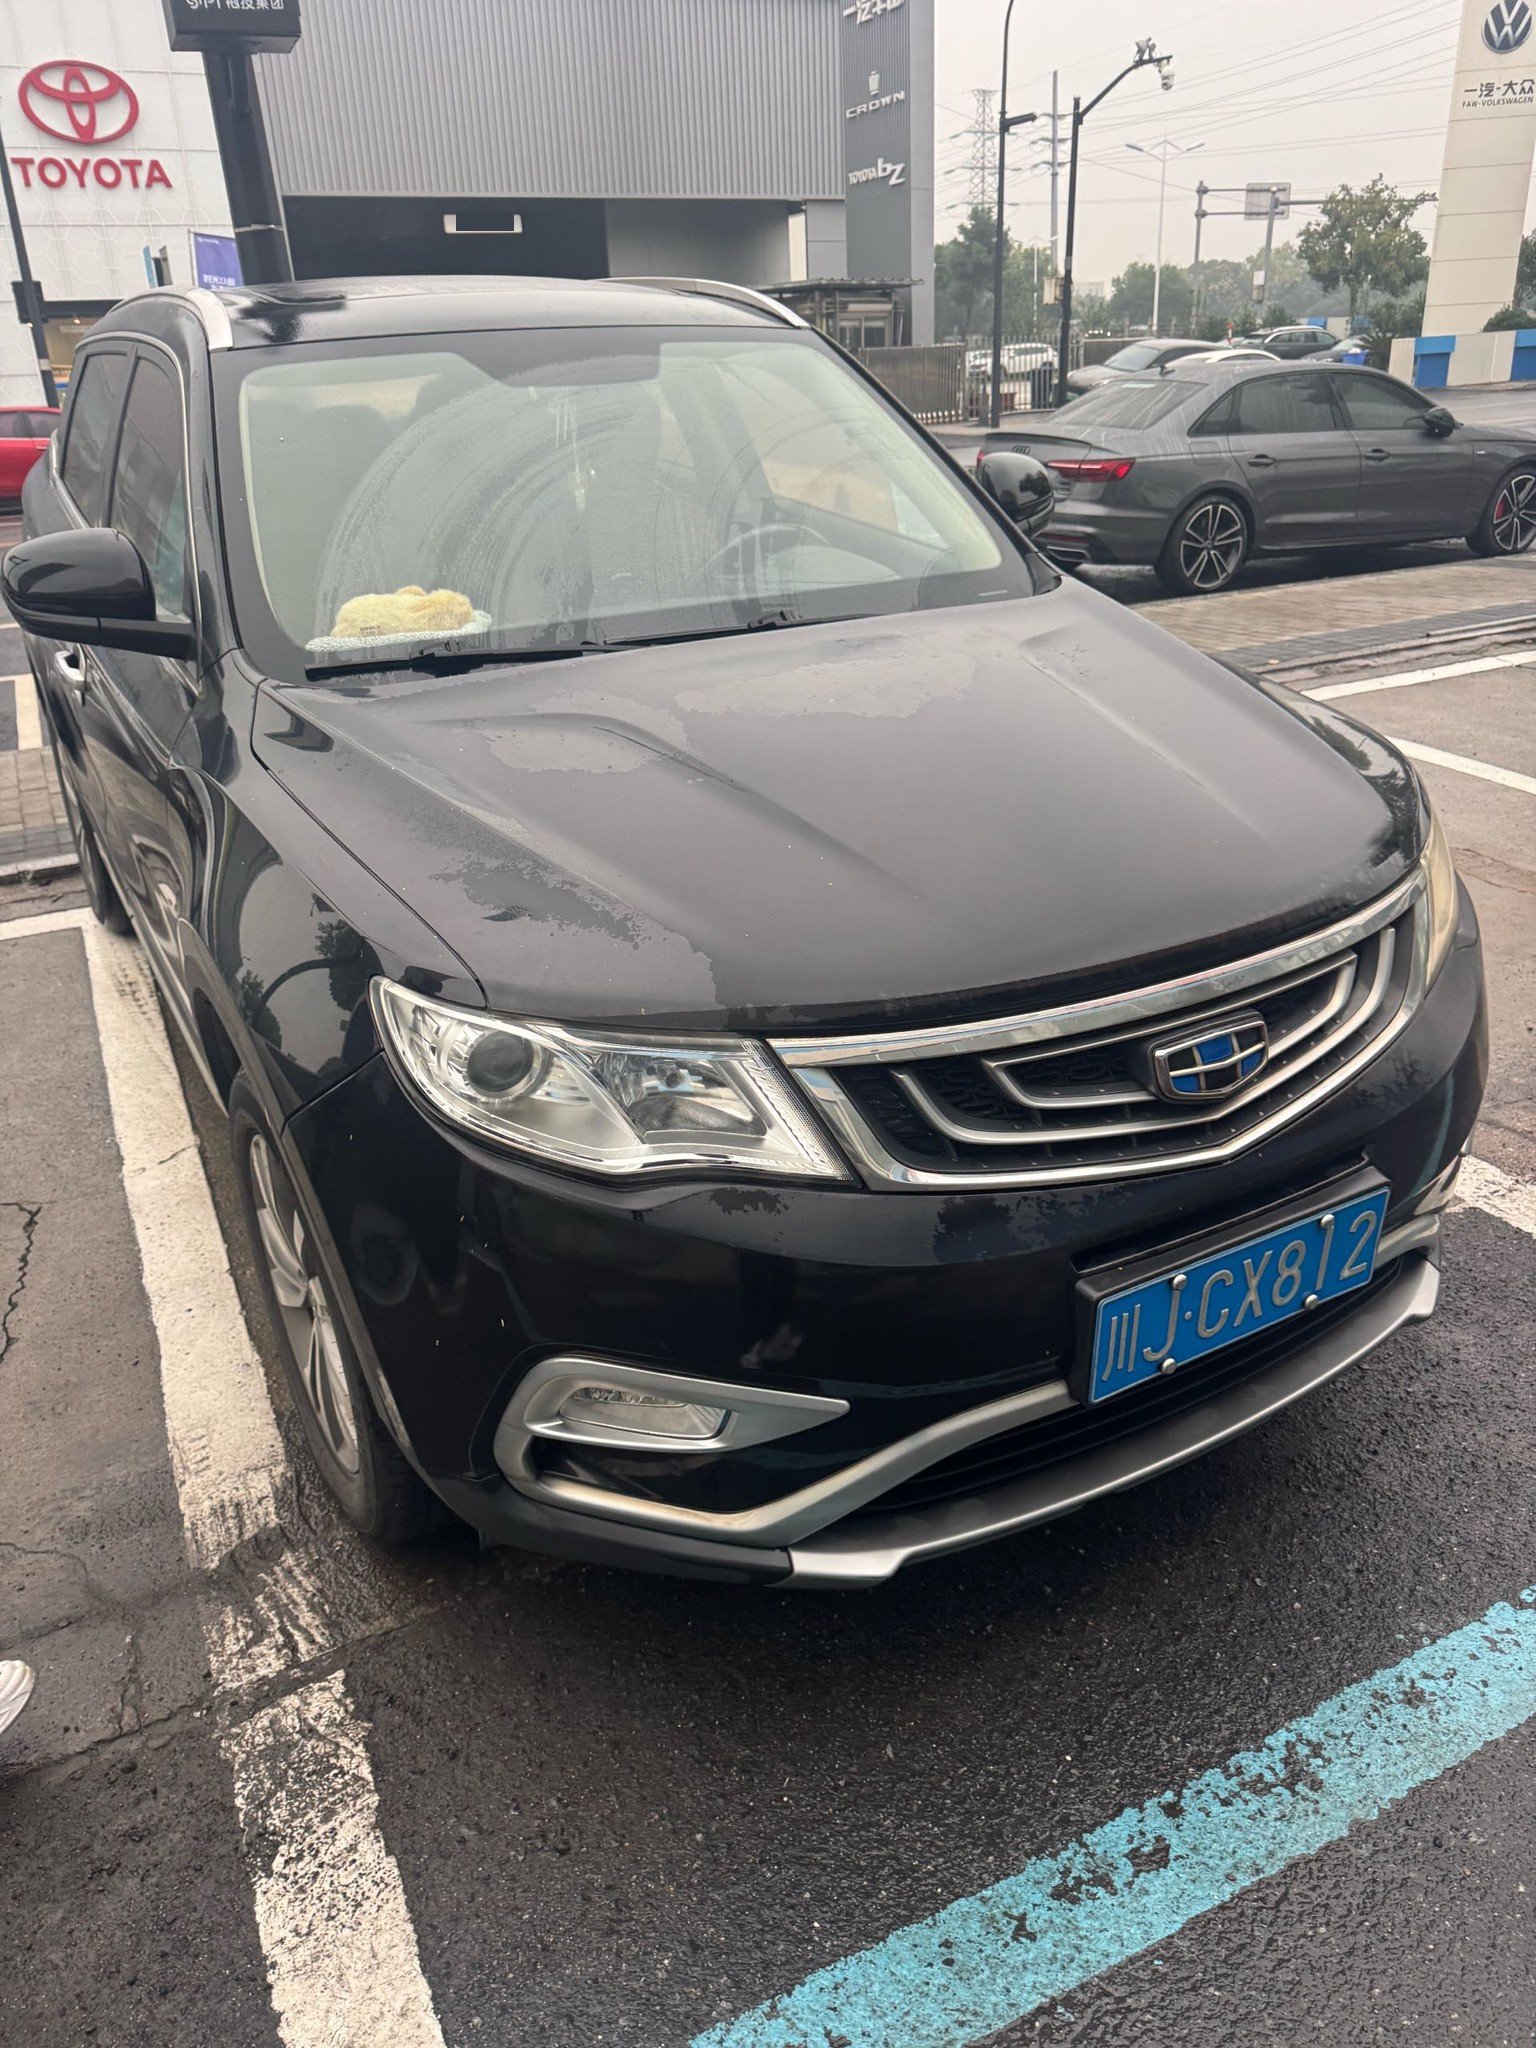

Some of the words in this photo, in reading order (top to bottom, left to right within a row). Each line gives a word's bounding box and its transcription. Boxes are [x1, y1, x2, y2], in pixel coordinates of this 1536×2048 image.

[846, 91, 905, 118] CROWN
[10, 157, 172, 189] TOYOTA
[848, 167, 877, 185] TOYOTA
[1101, 1210, 1377, 1382] 川J·CX812
